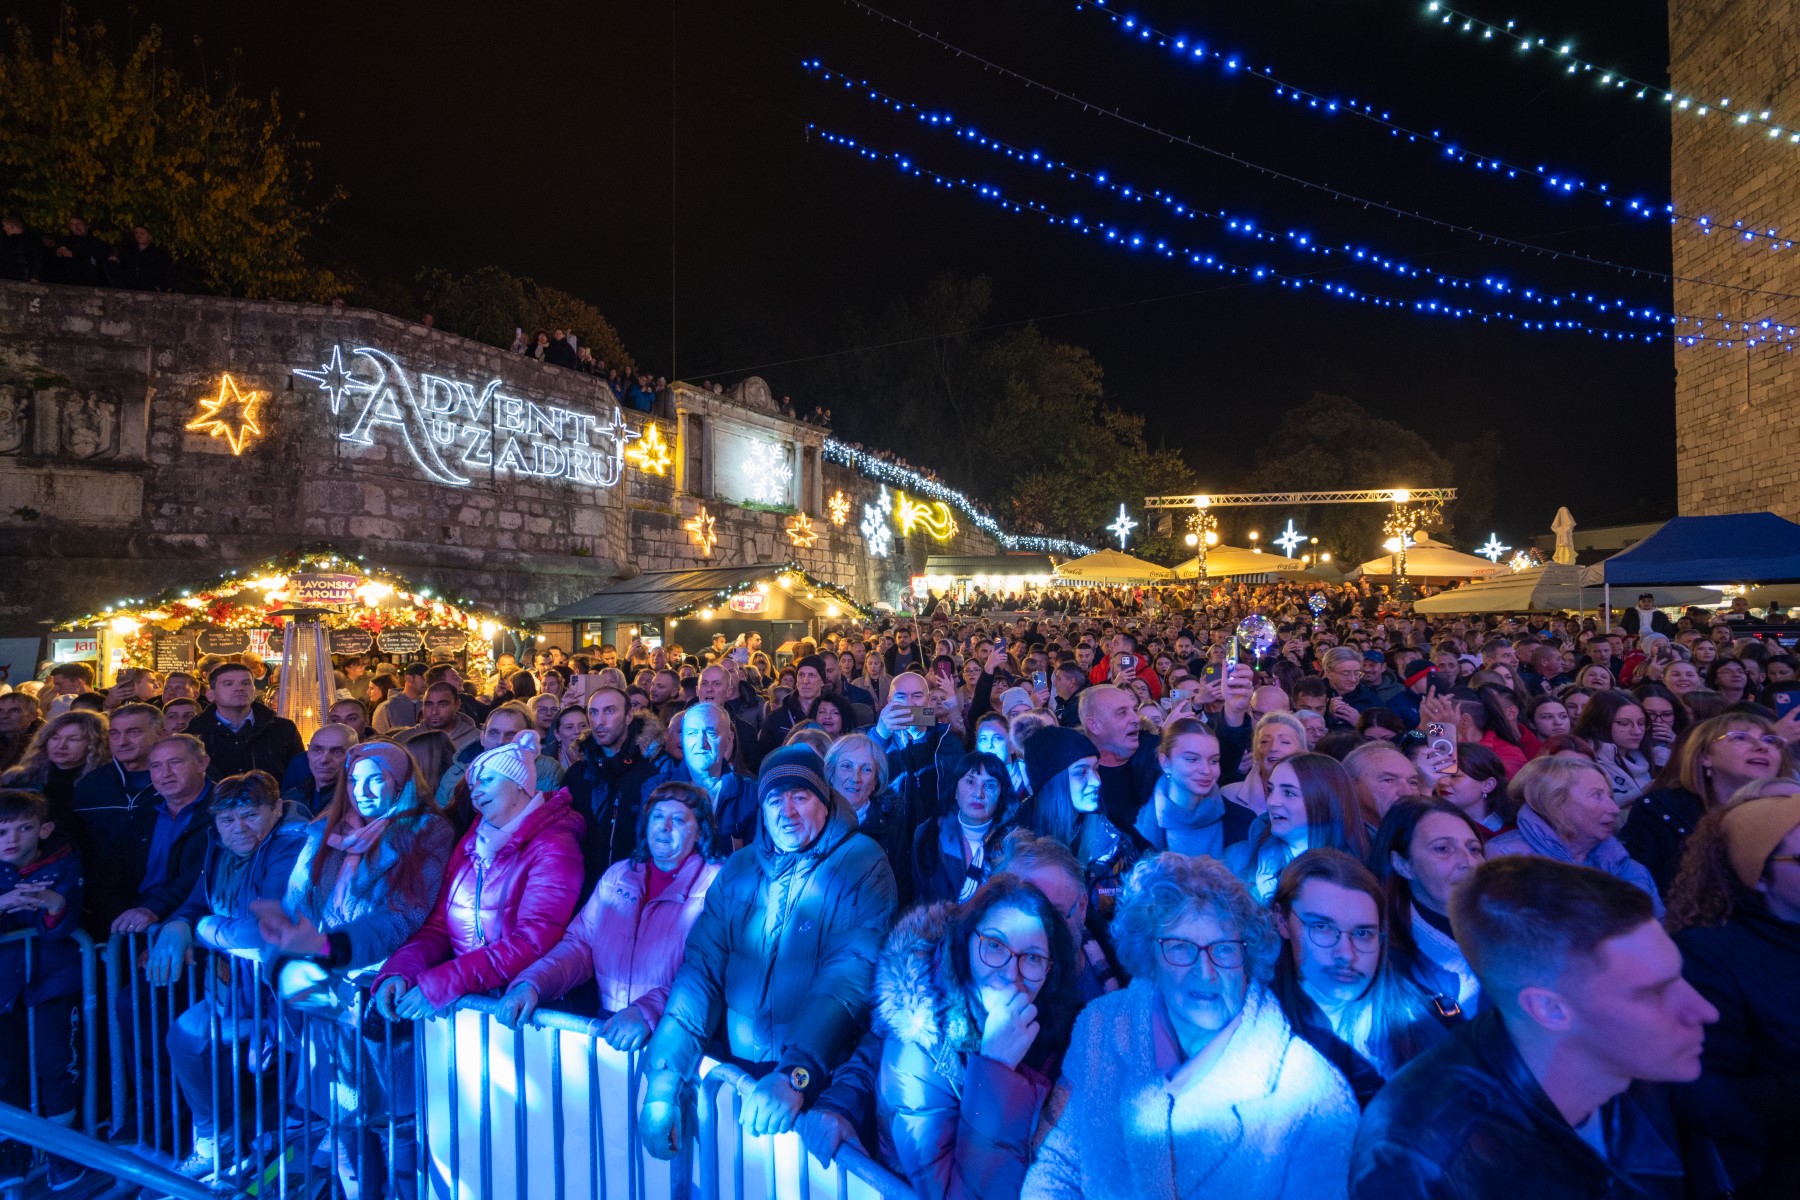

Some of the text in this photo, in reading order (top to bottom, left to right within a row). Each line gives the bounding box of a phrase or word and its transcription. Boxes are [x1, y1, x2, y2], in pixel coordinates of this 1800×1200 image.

[339, 347, 596, 485] ADVENT
[433, 418, 621, 487] U ZADRU
[290, 580, 357, 590] SLAVONSKA
